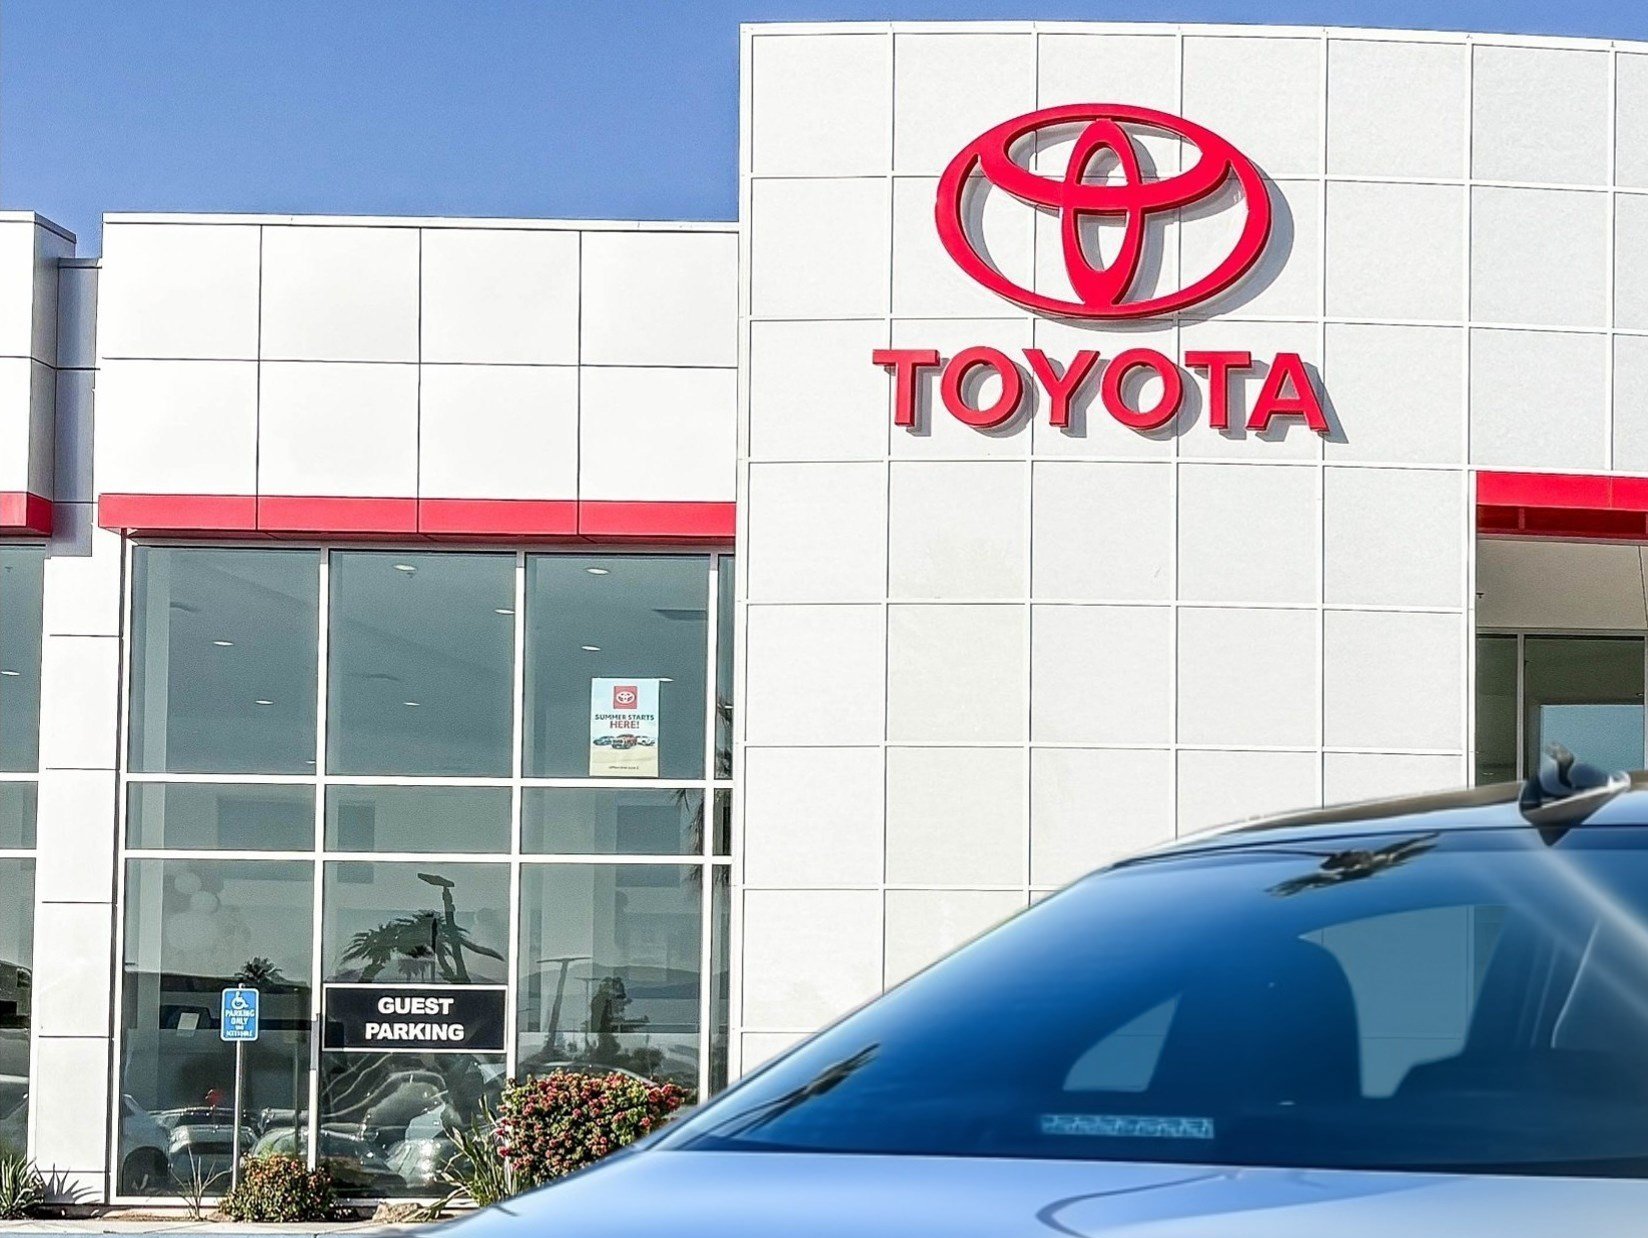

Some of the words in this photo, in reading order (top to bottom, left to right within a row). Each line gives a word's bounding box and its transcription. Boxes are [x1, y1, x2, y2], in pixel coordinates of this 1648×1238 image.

[873, 346, 1329, 431] TOYOTA
[609, 720, 640, 729] HERE!
[377, 997, 454, 1014] GUEST
[365, 1023, 464, 1040] PARKING
